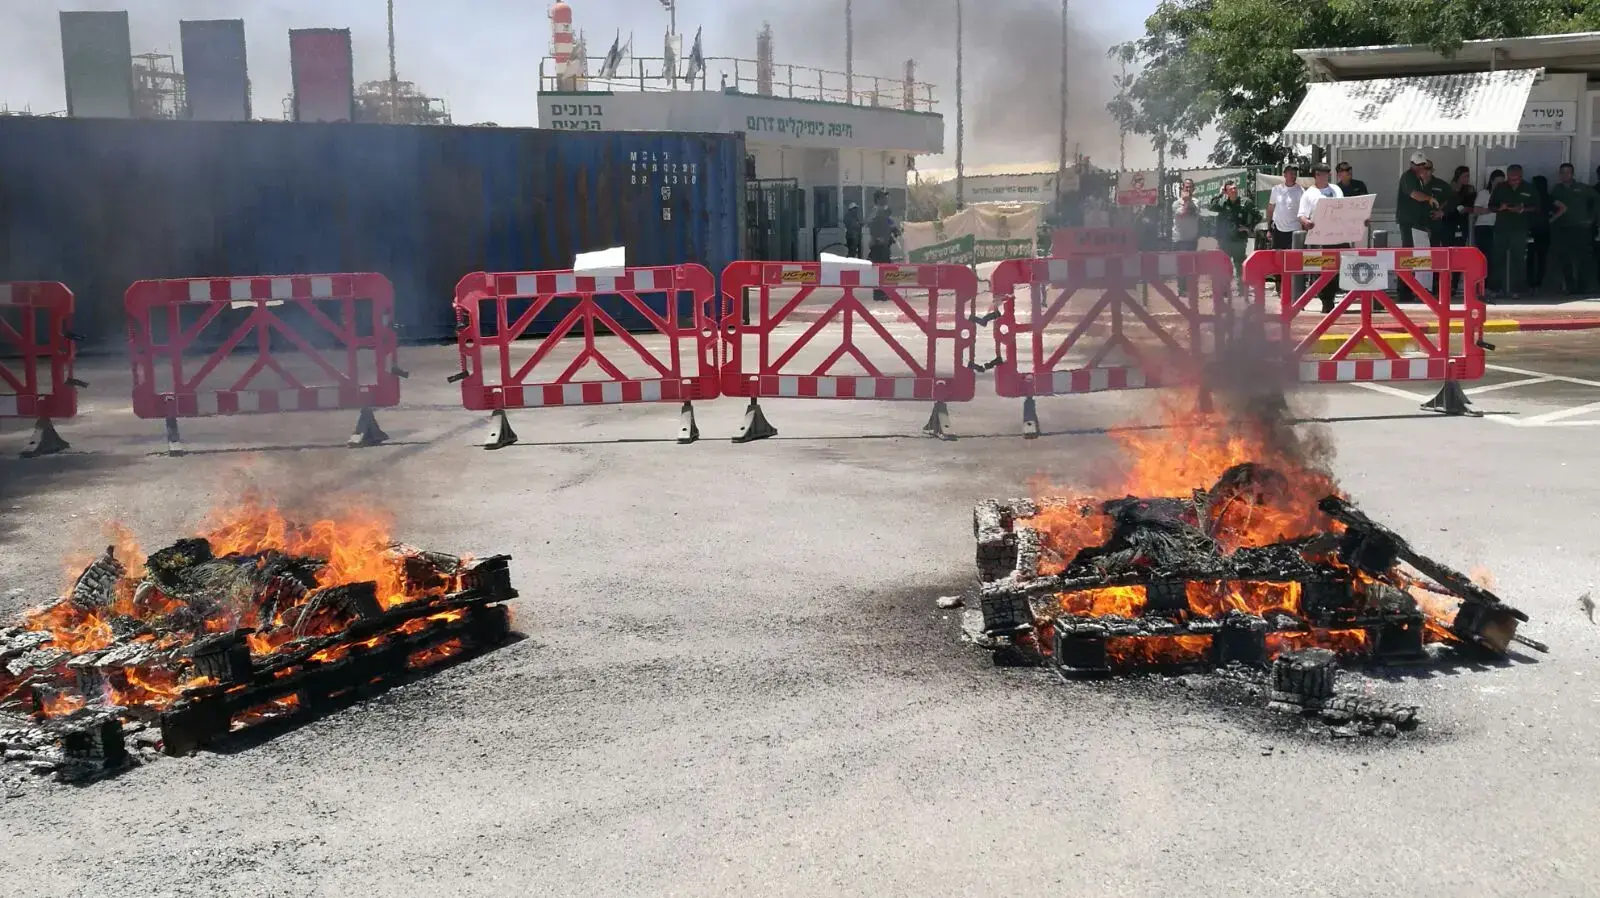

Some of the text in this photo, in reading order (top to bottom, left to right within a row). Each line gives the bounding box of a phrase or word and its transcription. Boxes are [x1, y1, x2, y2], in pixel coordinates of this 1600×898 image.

[551, 104, 603, 116] ברוכים
[1532, 108, 1564, 118] משרד
[747, 116, 854, 138] חיפה כימיקלים דרום
